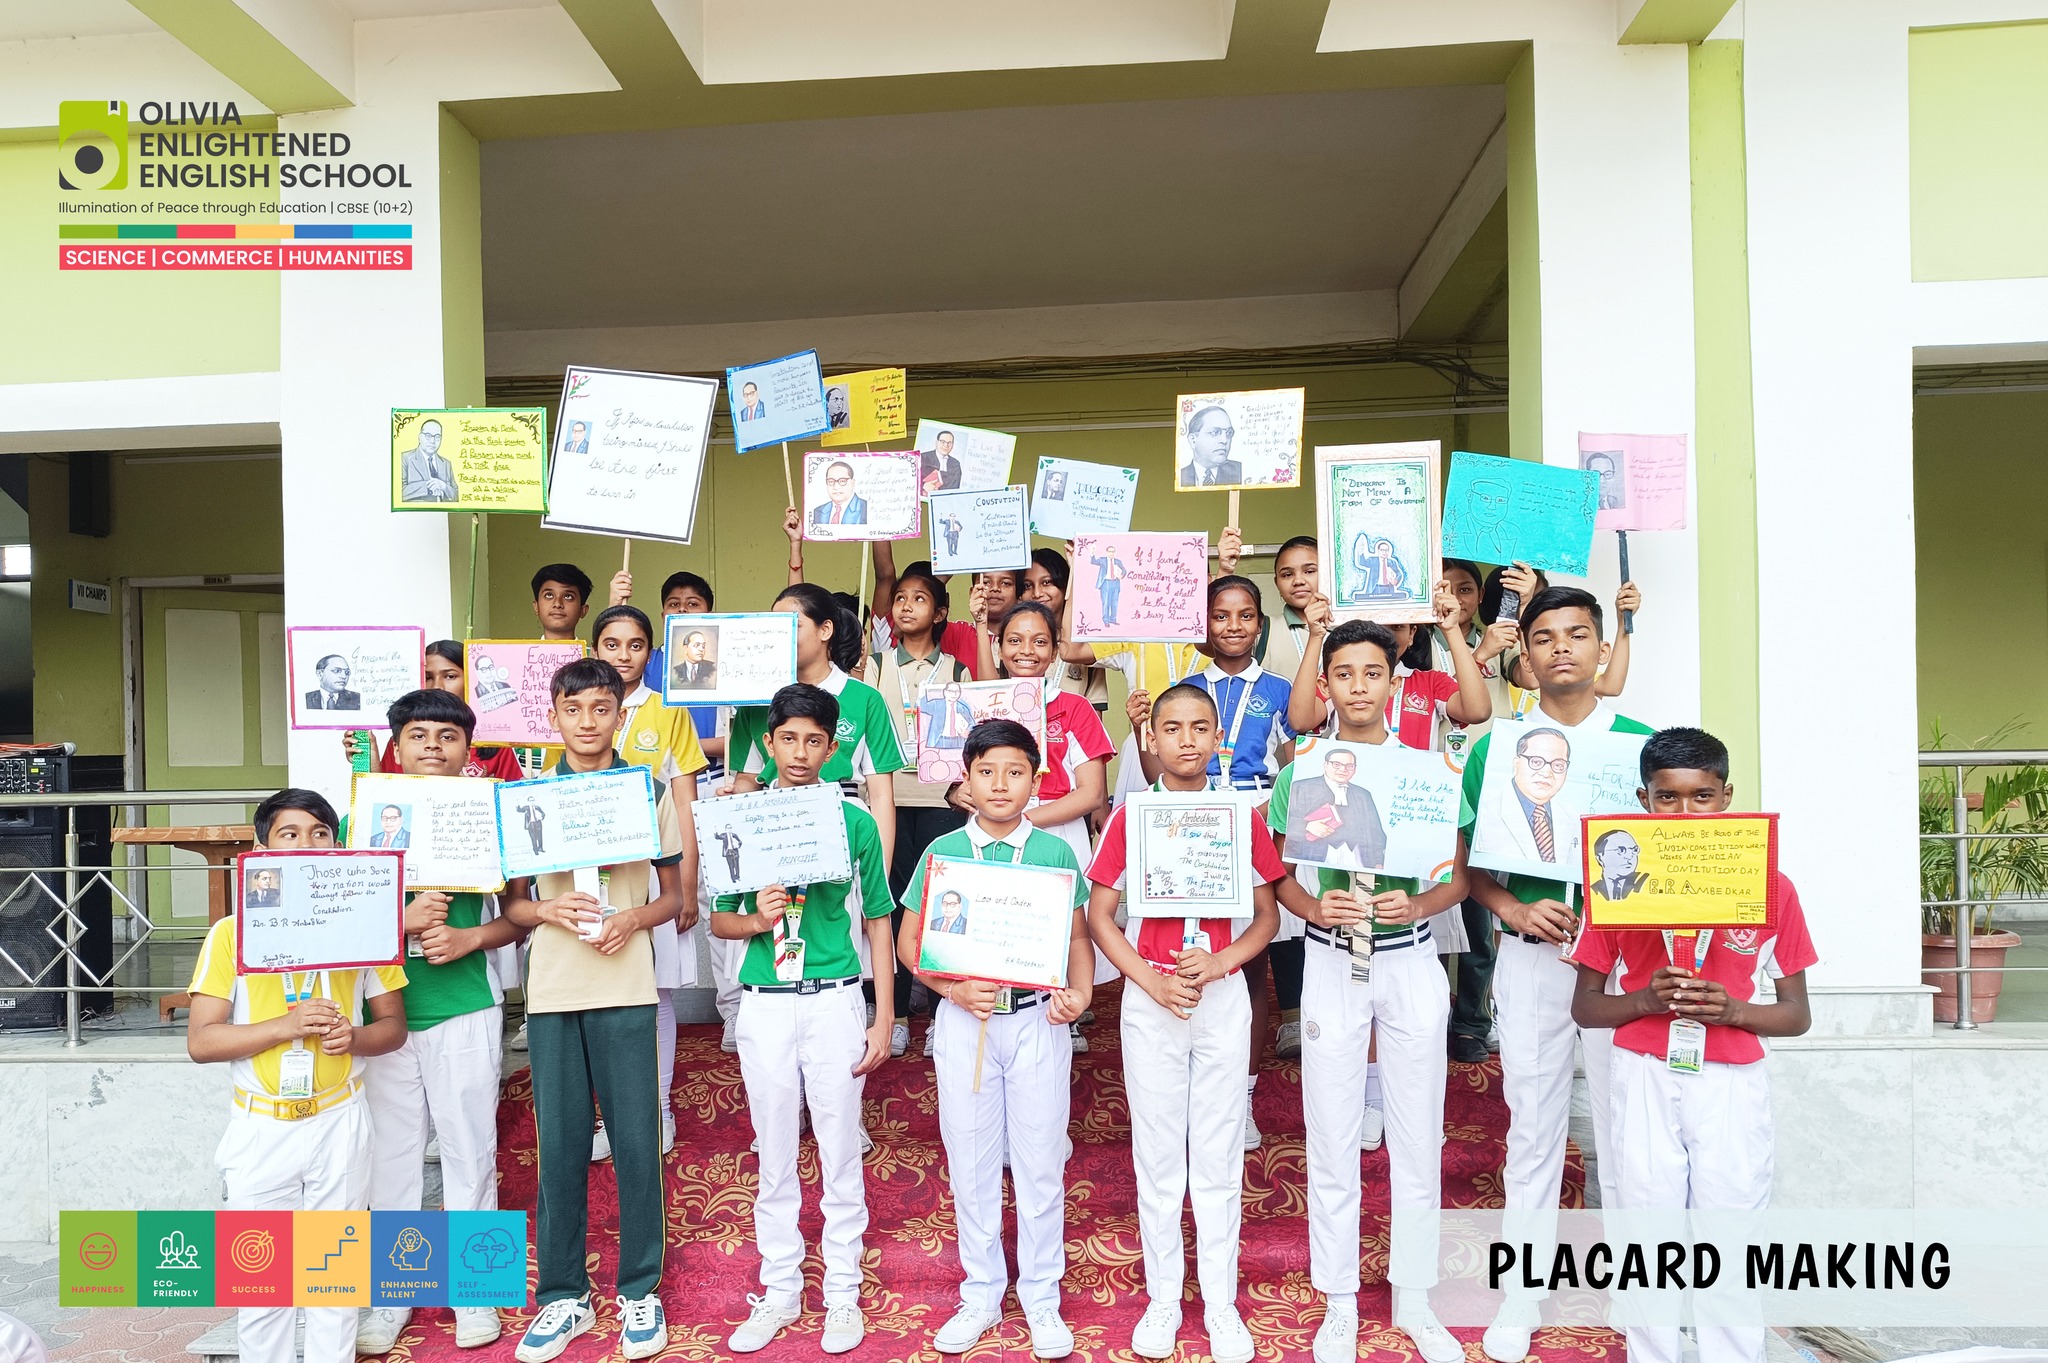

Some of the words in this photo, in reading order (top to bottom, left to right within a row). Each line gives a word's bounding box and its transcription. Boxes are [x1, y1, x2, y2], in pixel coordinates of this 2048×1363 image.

[645, 462, 678, 480] first
[1395, 477, 1407, 486] IS
[1342, 488, 1362, 498] NOT
[1404, 486, 1412, 496] A
[1339, 500, 1363, 508] FORM
[1171, 563, 1193, 575] the
[1173, 575, 1199, 592] being
[77, 584, 85, 598] VII
[85, 585, 107, 602] CHAMPS
[1174, 588, 1195, 598] shall
[1141, 596, 1152, 607] be
[1153, 597, 1168, 608] the
[1168, 598, 1187, 614] first
[988, 691, 1006, 707] I
[973, 709, 990, 719] like
[992, 707, 1011, 717] the
[1435, 783, 1454, 795] the
[560, 808, 587, 821] would
[1179, 811, 1220, 823] Ambedkar
[1650, 827, 1695, 840] ALWAYS
[1700, 829, 1710, 838] BE
[1713, 829, 1731, 837] PROUD
[1733, 829, 1743, 837] OF
[1746, 829, 1760, 837] THE
[1686, 853, 1697, 861] AN
[1700, 853, 1742, 861] INDIAN
[1179, 857, 1193, 865] The
[1193, 859, 1230, 871] Constitution
[299, 864, 342, 881] Those
[346, 865, 366, 876] who
[1152, 866, 1173, 879] Slogan
[1740, 866, 1760, 875] DAY
[309, 881, 328, 890] their
[332, 880, 364, 890] nation
[1186, 877, 1198, 886] The
[1217, 884, 1226, 892] To
[1680, 879, 1752, 896] AMBEDKAR
[268, 918, 279, 927] B
[280, 917, 289, 927] R
